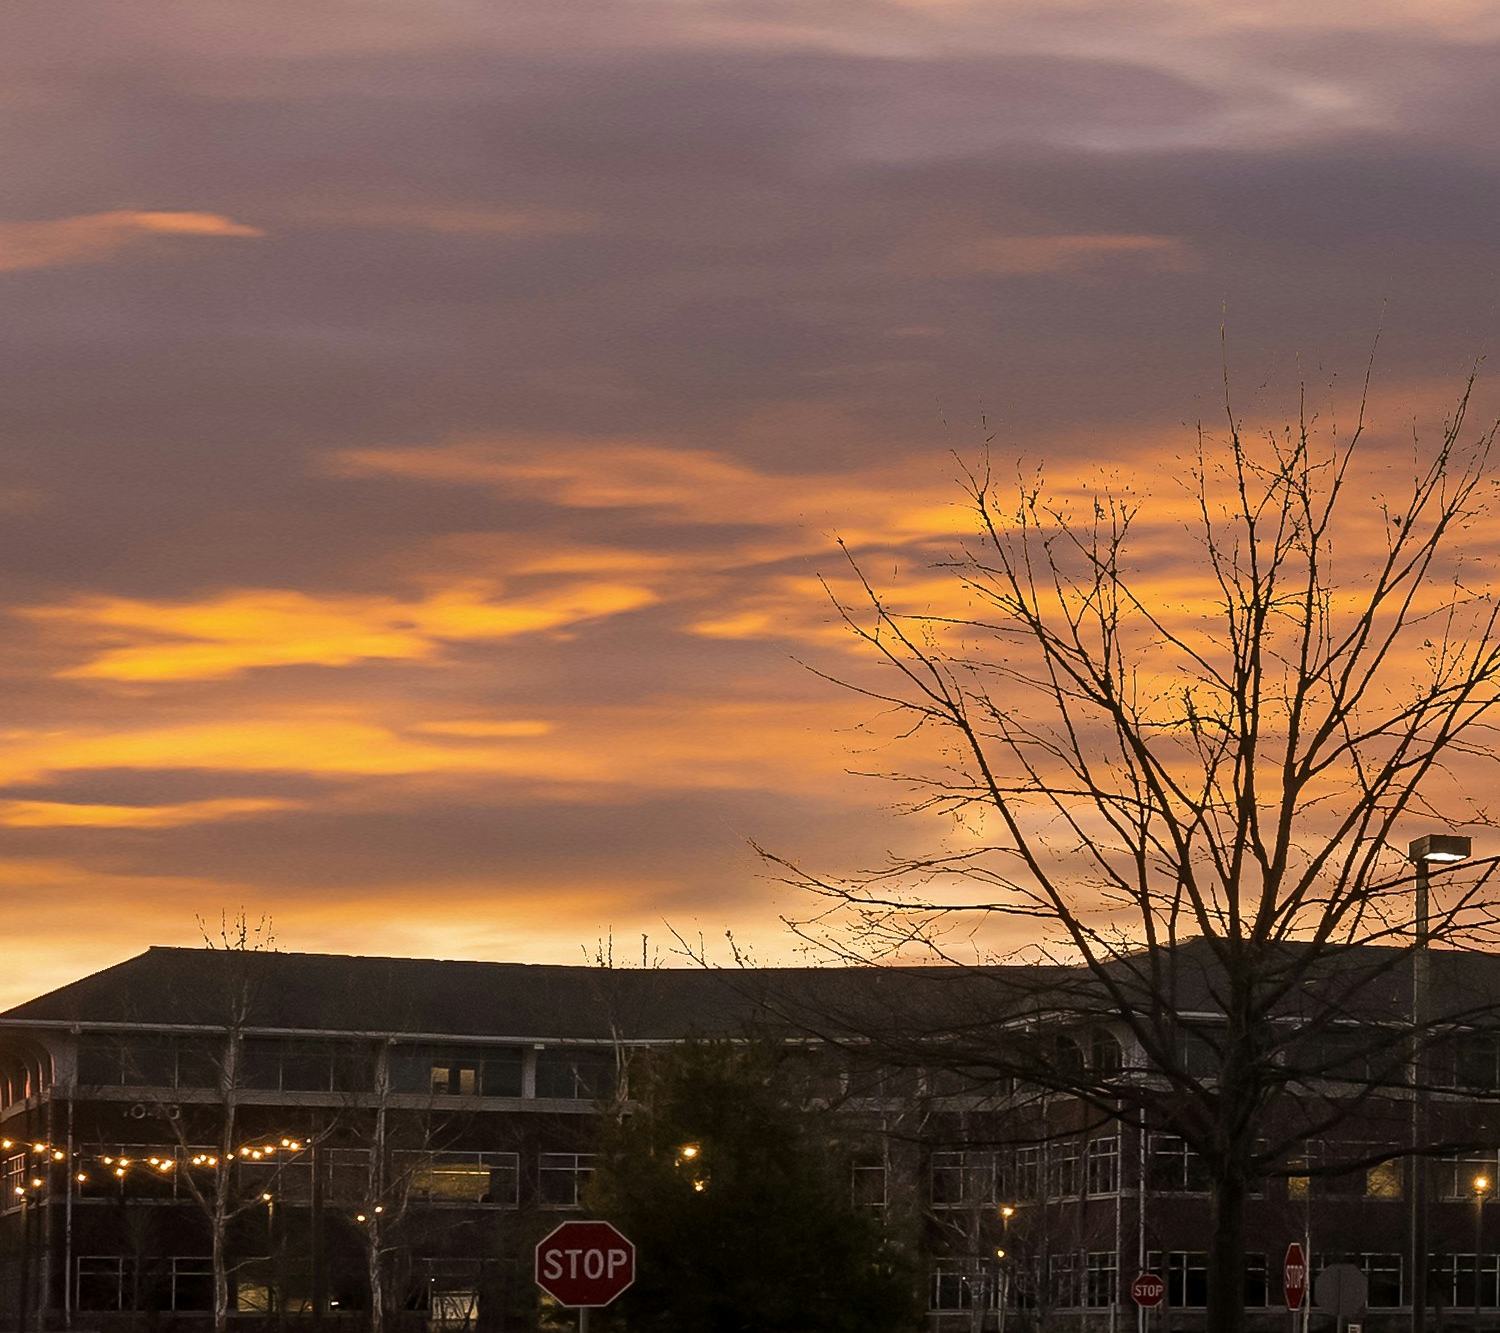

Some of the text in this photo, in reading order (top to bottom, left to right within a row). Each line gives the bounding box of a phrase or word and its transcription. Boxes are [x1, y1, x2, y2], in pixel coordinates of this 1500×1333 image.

[543, 1249, 627, 1280] STOP
[1285, 1265, 1304, 1288] STOP
[1134, 1284, 1163, 1297] STOP
